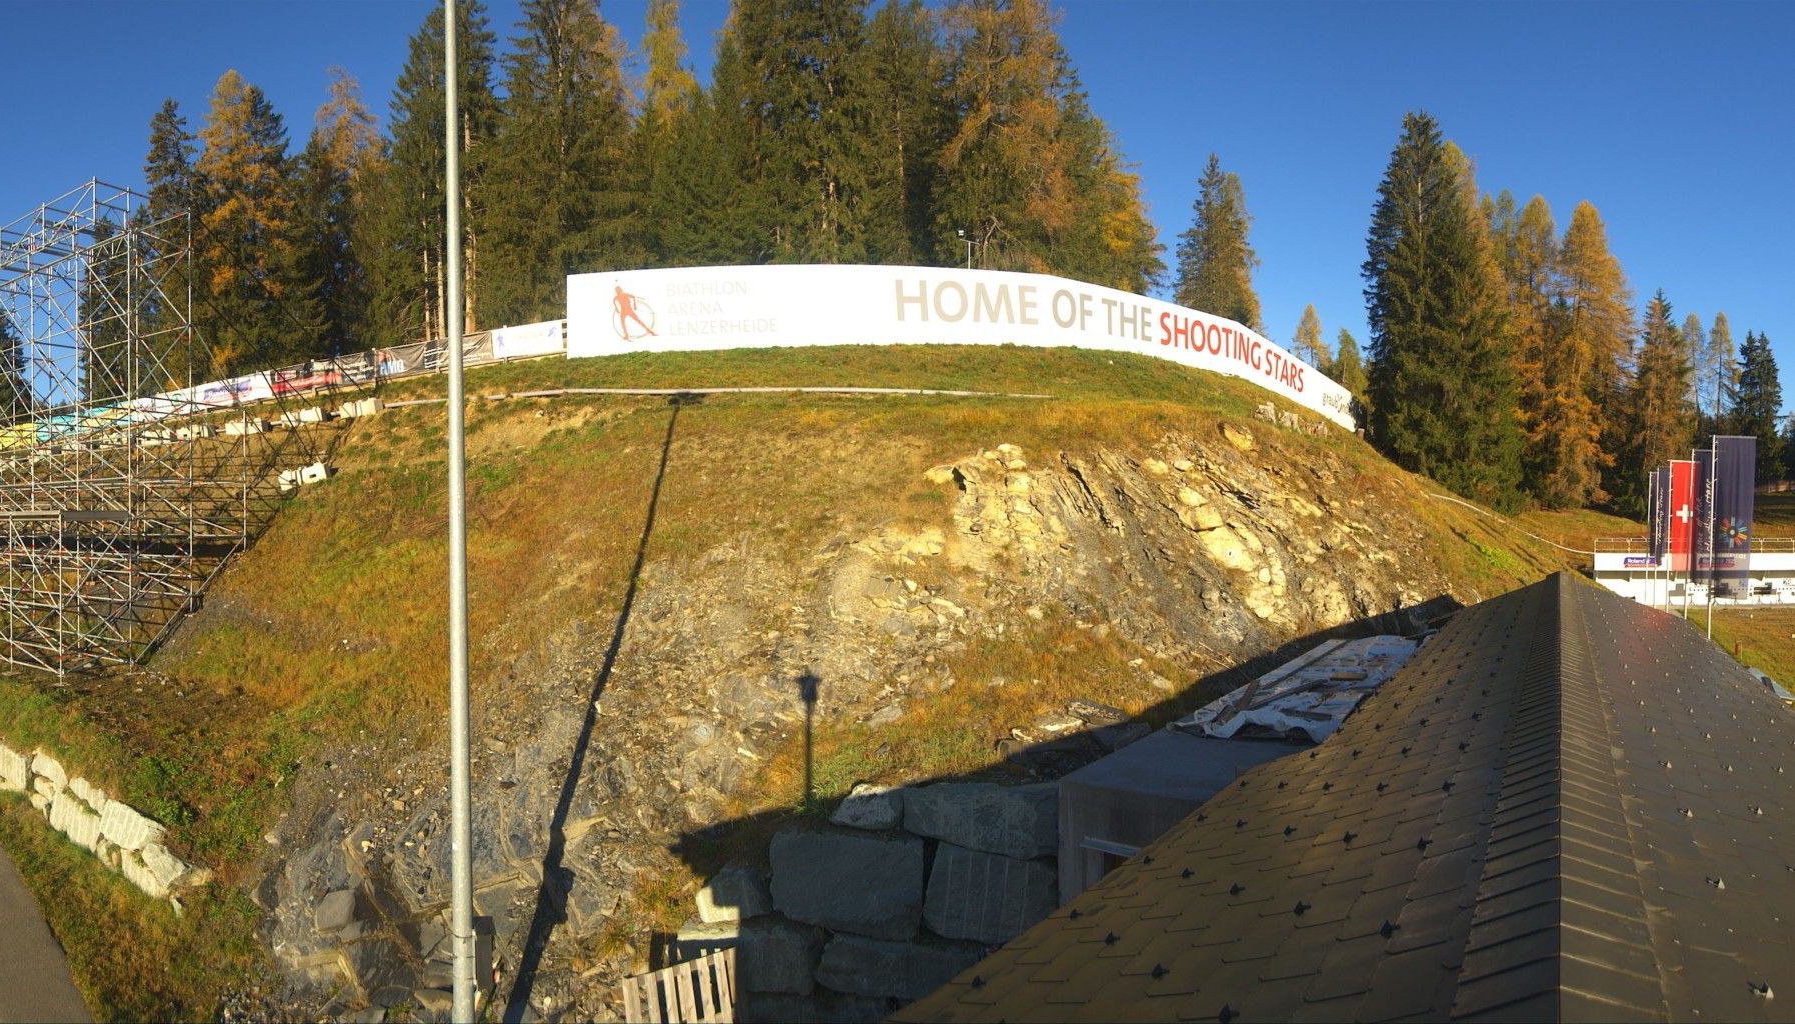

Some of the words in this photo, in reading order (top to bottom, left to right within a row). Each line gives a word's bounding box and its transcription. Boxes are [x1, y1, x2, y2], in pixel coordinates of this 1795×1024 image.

[666, 281, 747, 297] BIATHLON
[667, 301, 723, 316] ARENA
[668, 318, 778, 336] LENZERHEIDE
[894, 279, 1039, 325] HOME
[1051, 288, 1093, 331] OF
[1101, 297, 1152, 342] THE
[1159, 311, 1261, 370] SHOOTING
[1265, 349, 1304, 393] STARS
